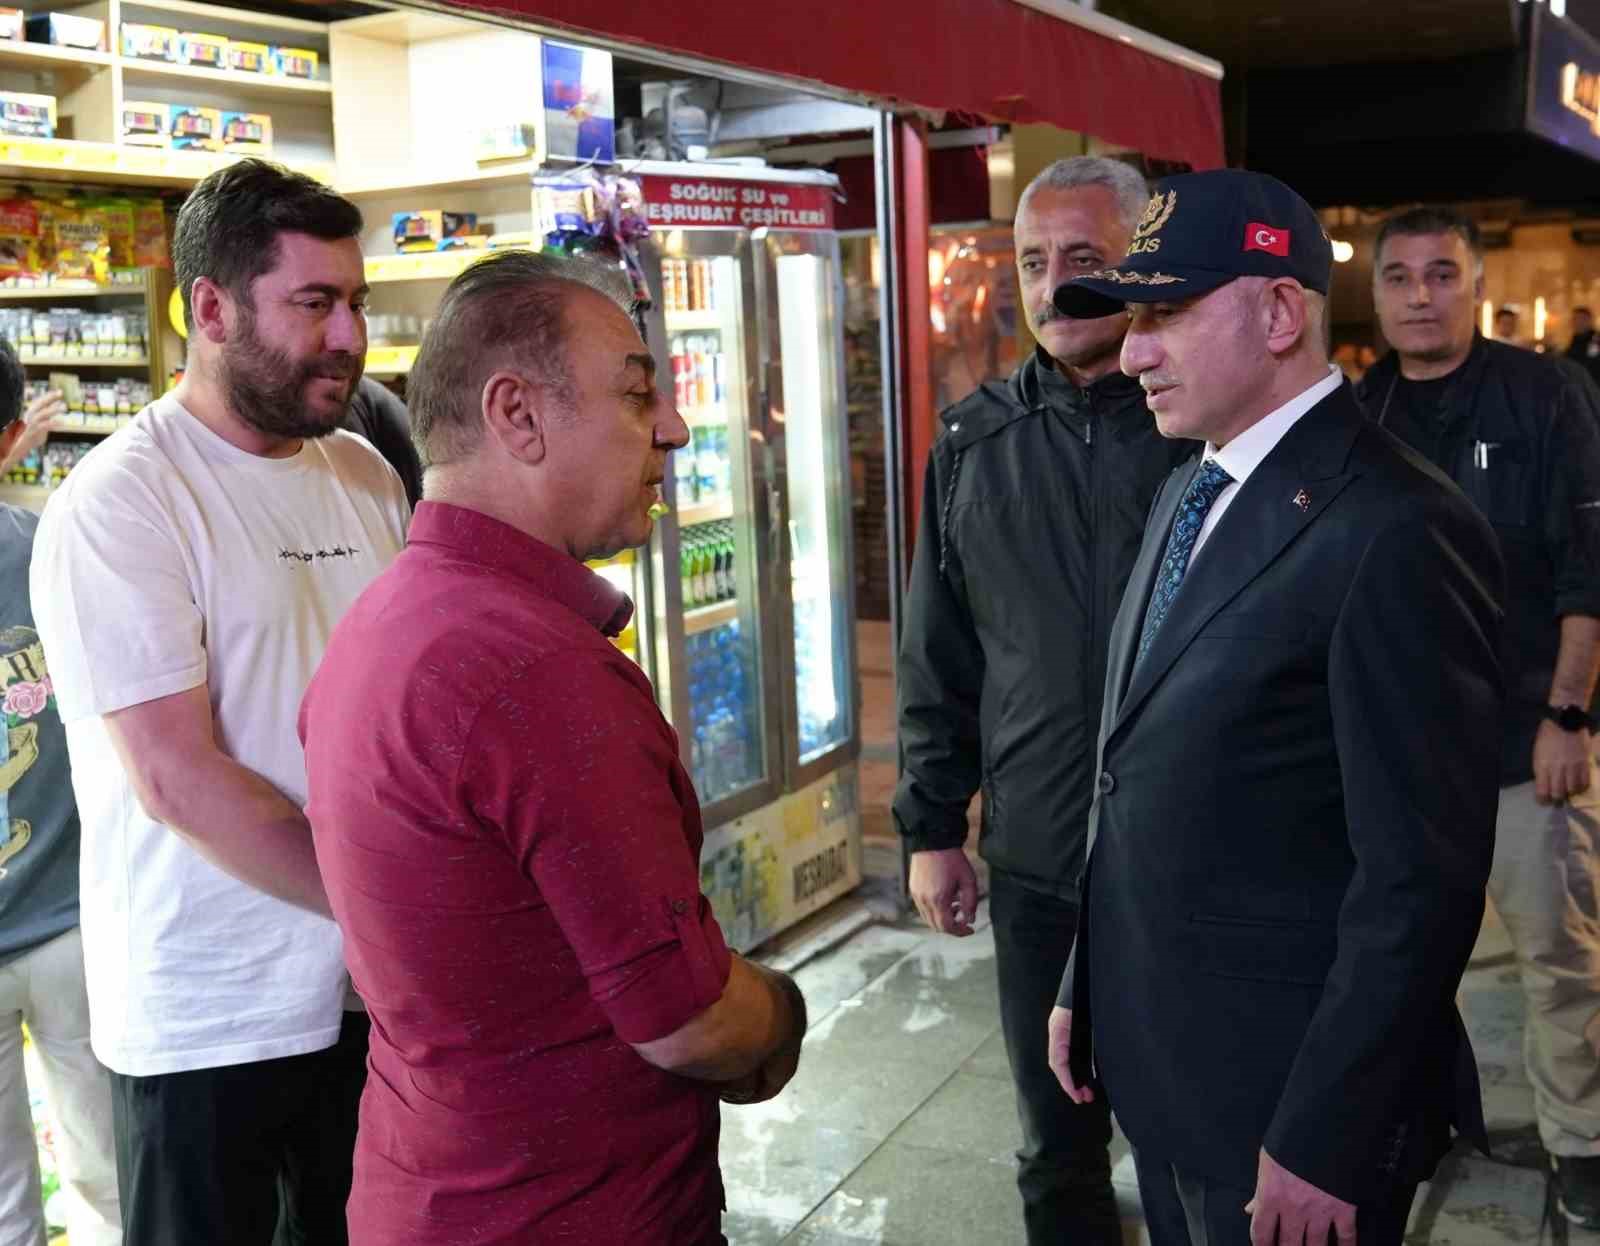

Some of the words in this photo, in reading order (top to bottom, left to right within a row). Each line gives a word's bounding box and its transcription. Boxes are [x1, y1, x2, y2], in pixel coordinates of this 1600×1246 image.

[670, 183, 736, 202] SOĞUK
[741, 188, 765, 204] SU
[770, 193, 789, 205] ve
